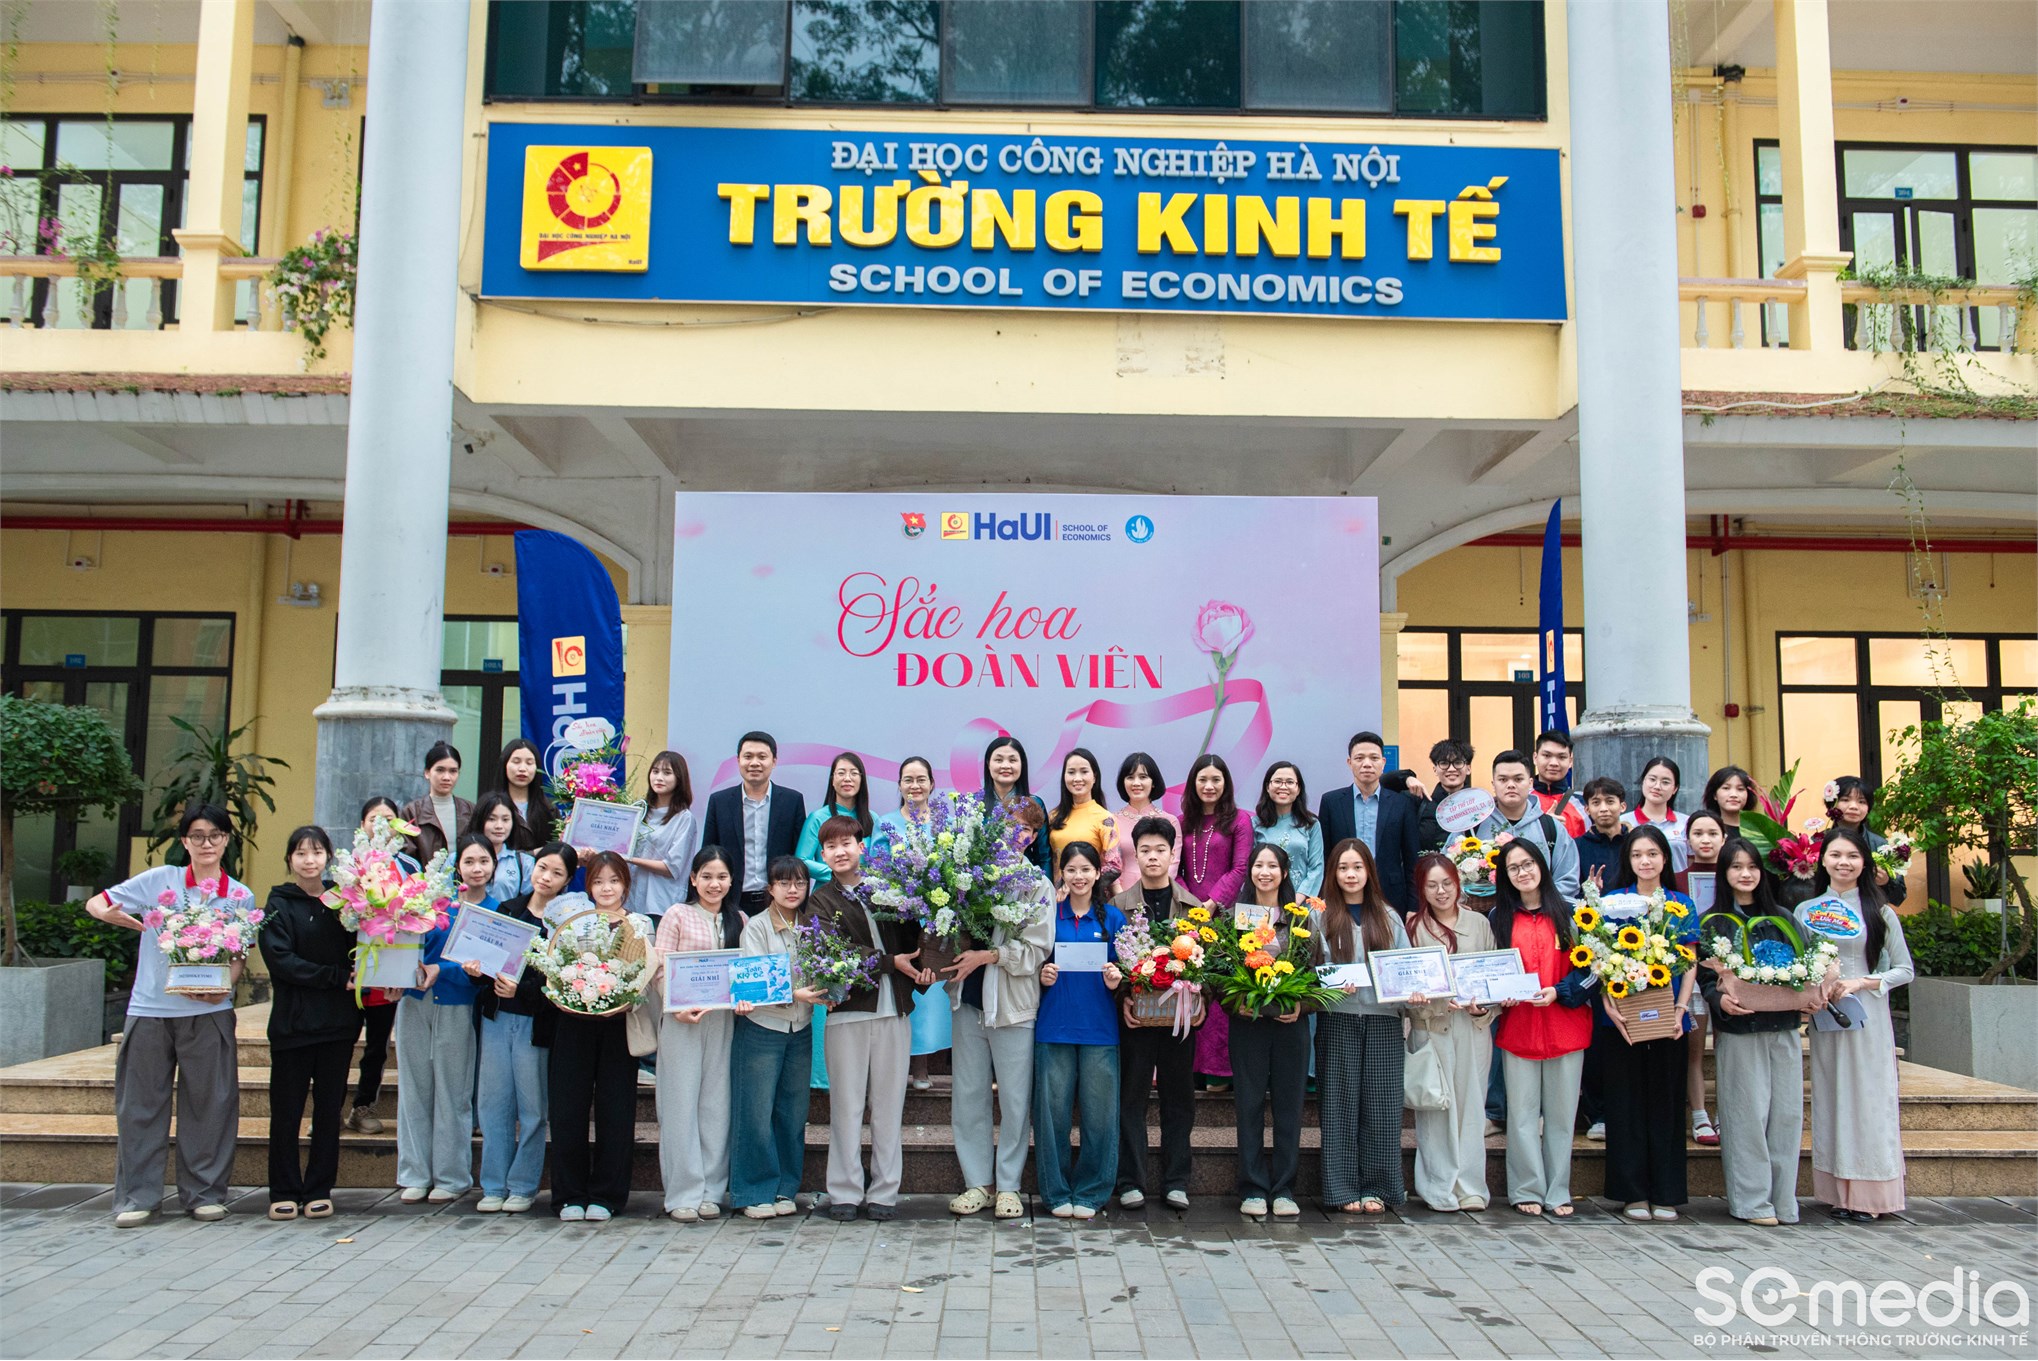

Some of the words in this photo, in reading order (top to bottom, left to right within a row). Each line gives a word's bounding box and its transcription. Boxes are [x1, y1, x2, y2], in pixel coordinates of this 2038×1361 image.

[832, 141, 898, 176] ĐẠI
[908, 143, 988, 177] HỌC
[1000, 138, 1103, 175] CÔNG
[1115, 142, 1256, 185] NGHIỆP
[1267, 144, 1322, 181] HÀ
[1333, 146, 1401, 189] NỘI
[718, 170, 1103, 254] TRƯỜNG
[1137, 192, 1366, 261] KINH
[1393, 176, 1510, 264] TẾ
[828, 264, 1023, 297] SCHOOL
[1043, 269, 1102, 297] OF
[1122, 271, 1403, 306] ECONOMICS
[974, 513, 1051, 541] HaUI
[1062, 524, 1095, 532] SCHOOL
[1097, 524, 1108, 532] OF
[1062, 533, 1111, 541] ECONOMICS
[838, 572, 963, 657] Sắc
[976, 591, 1082, 640] hoa
[893, 643, 1039, 688] ĐOÀN
[1056, 644, 1163, 689] VIÊN
